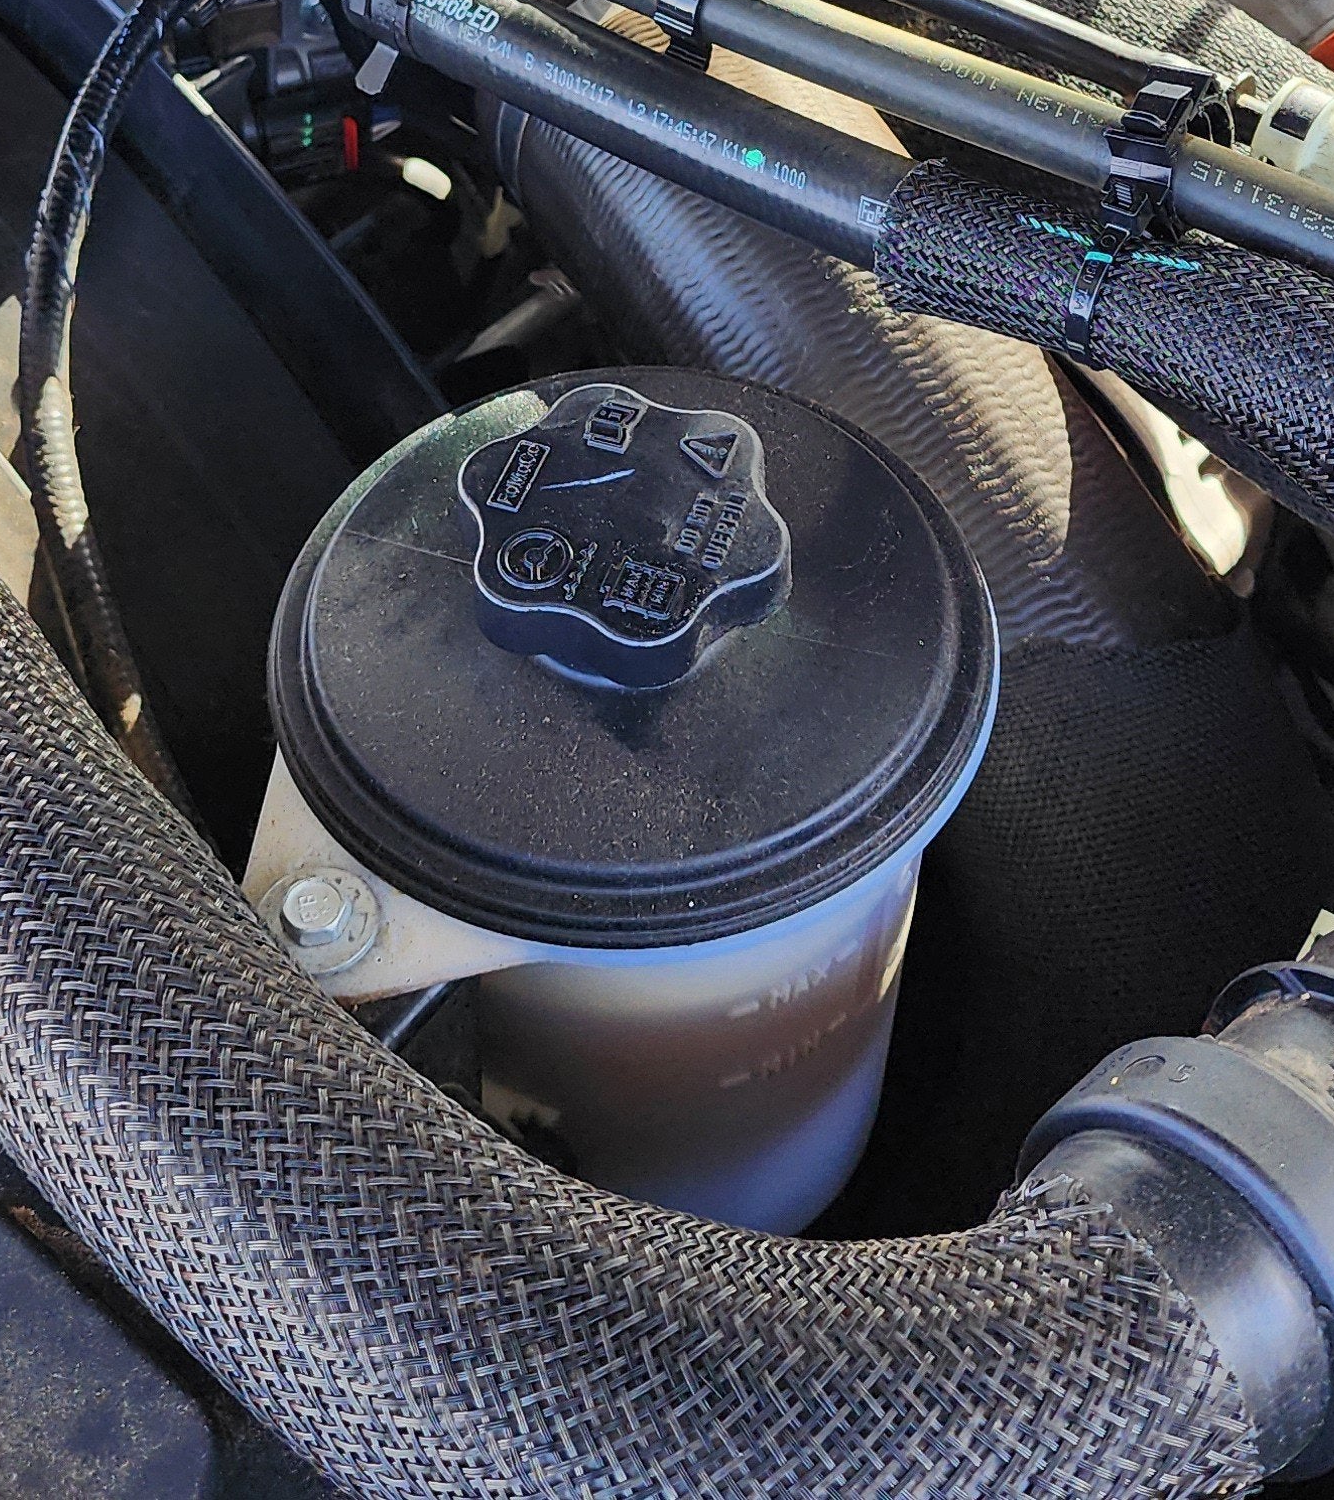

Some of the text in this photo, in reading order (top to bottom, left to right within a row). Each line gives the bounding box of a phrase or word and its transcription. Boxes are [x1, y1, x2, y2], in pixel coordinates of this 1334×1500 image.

[938, 59, 999, 92] 1000
[651, 107, 718, 150] 17:45:47
[773, 160, 808, 191] 1000
[491, 441, 547, 509] FoMoCo
[674, 491, 718, 556] DO NOT
[700, 491, 749, 570] OVERFILL
